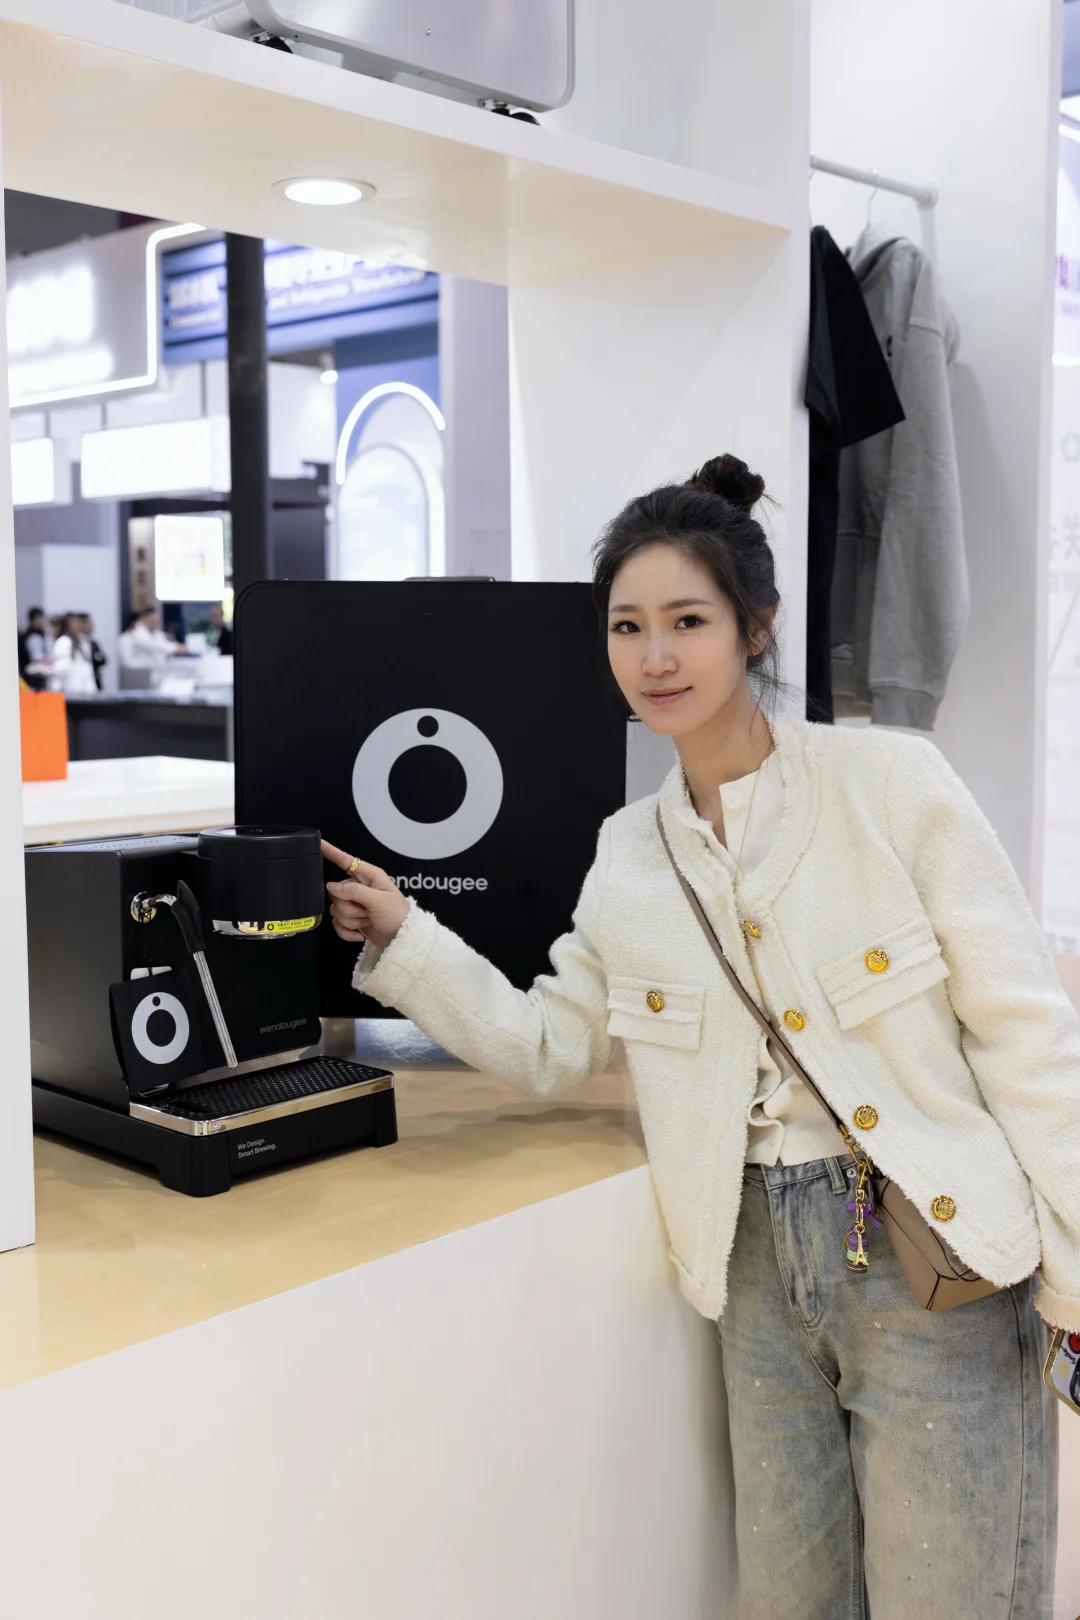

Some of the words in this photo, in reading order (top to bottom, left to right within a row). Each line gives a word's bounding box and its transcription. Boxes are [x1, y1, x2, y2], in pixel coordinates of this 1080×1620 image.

[259, 1018, 306, 1033] wendougee
[247, 1139, 265, 1148] Design
[237, 1149, 254, 1158] Smart
